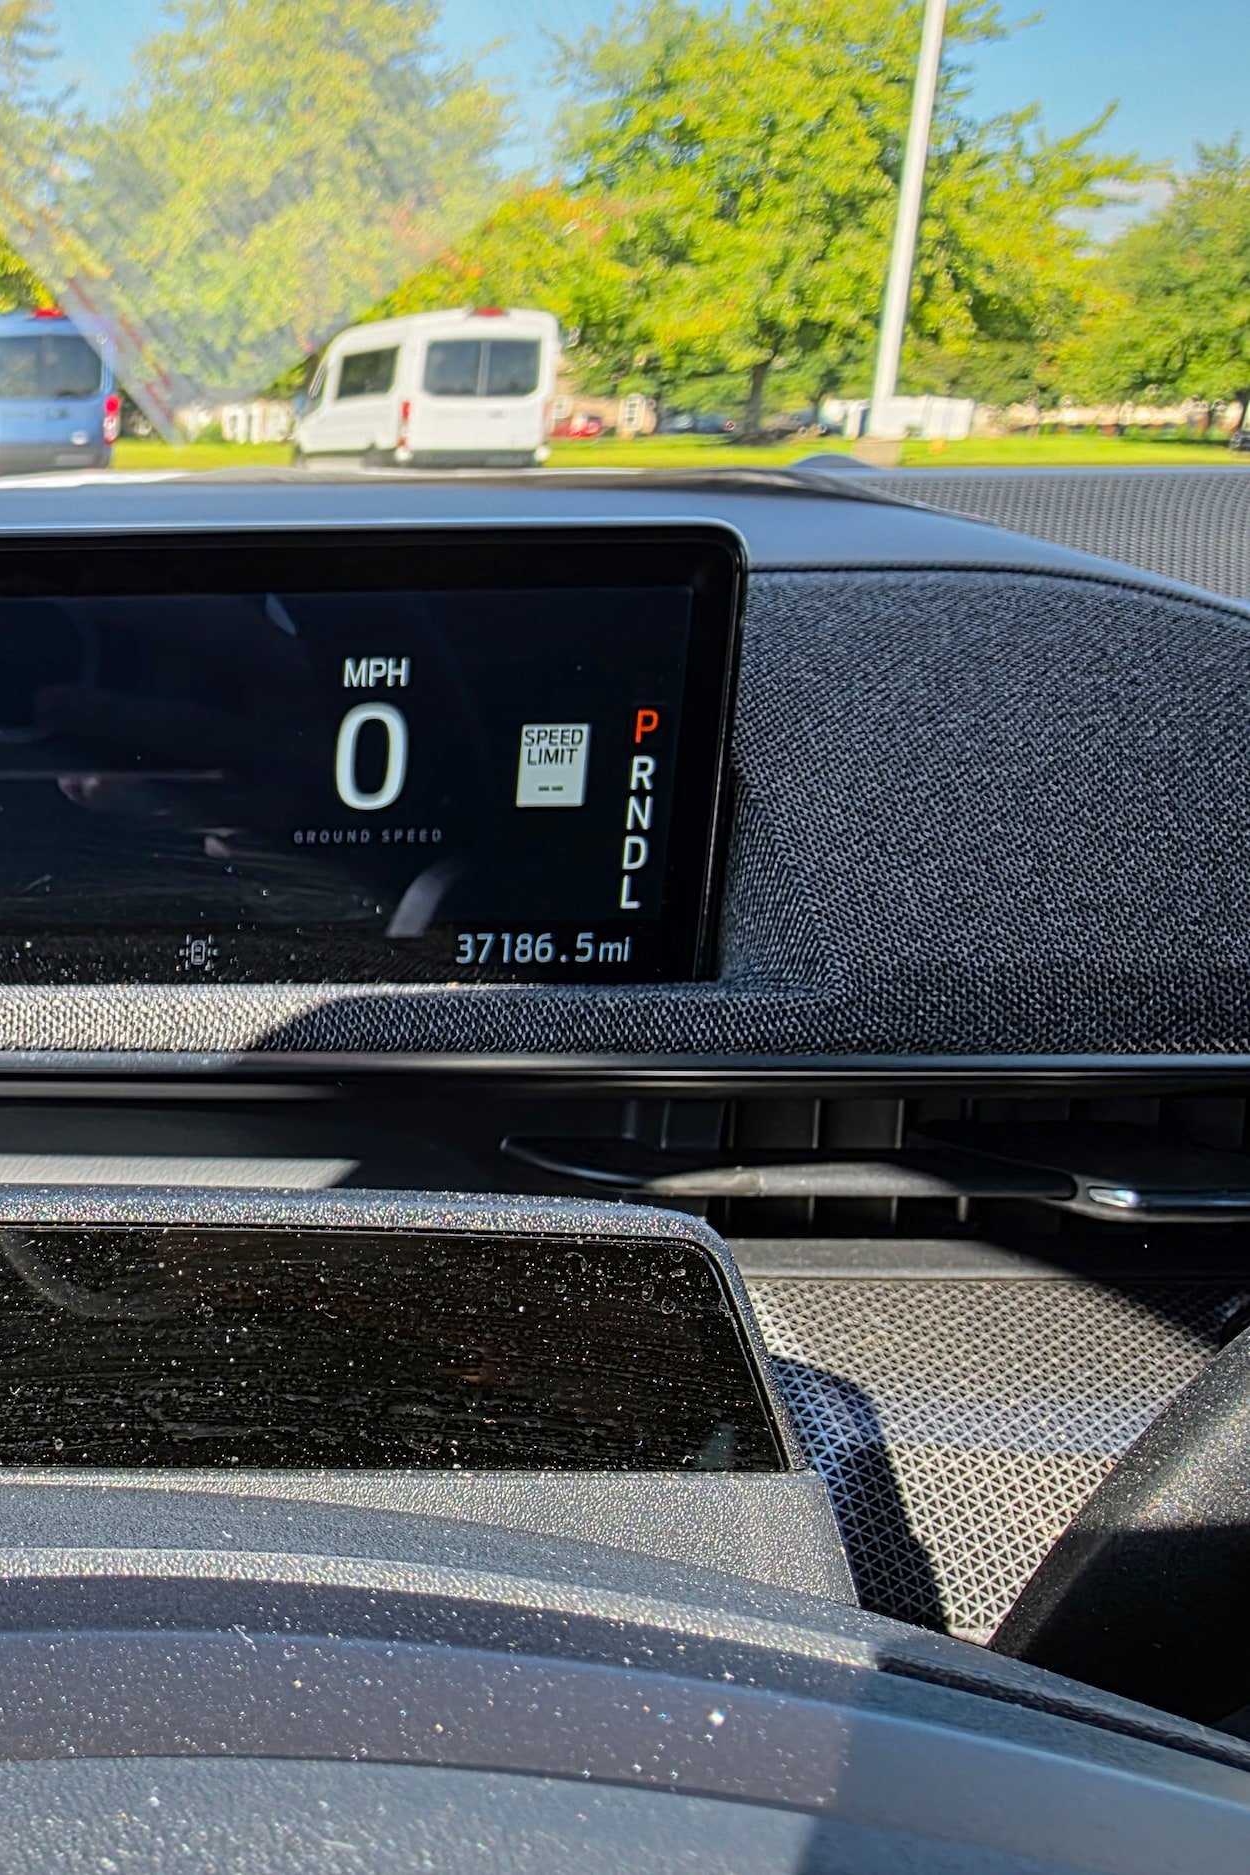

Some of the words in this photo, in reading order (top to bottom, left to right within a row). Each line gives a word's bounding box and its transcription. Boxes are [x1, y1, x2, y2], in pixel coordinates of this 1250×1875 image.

[343, 657, 410, 688] MPH
[523, 728, 584, 747] SPEED
[634, 709, 659, 744] P
[335, 702, 408, 811] 0
[526, 747, 578, 766] LIMIT
[630, 755, 656, 791] R
[626, 795, 653, 831] N
[293, 828, 371, 845] GROUND
[381, 827, 443, 843] SPEED
[622, 835, 649, 870] D
[620, 874, 641, 910] L
